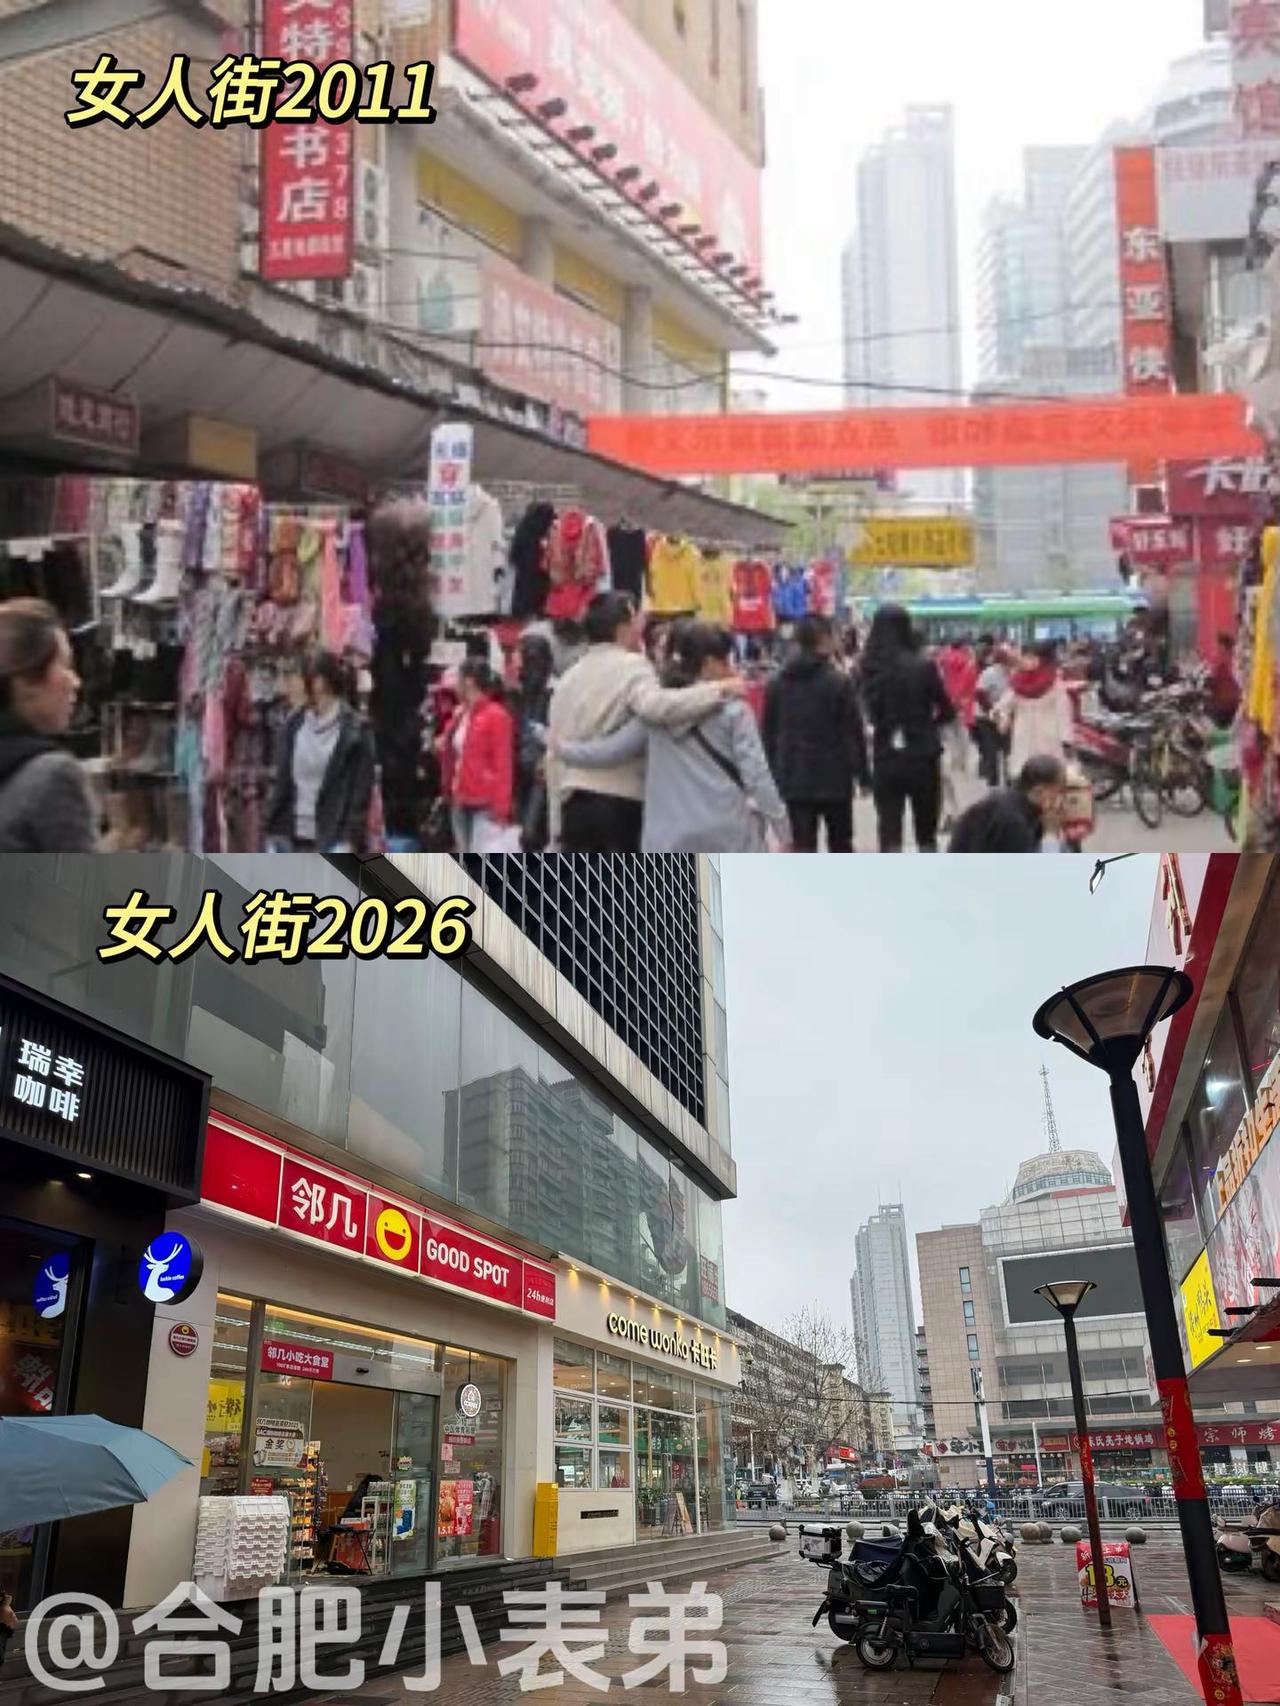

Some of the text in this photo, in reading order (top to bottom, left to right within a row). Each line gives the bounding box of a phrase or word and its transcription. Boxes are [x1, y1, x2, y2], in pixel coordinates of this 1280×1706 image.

[276, 0, 334, 222] 特书店
[17, 1038, 85, 1087] 瑞幸
[13, 1073, 81, 1122] 咖啡
[290, 1177, 358, 1240] 邻几
[425, 1238, 510, 1288] GOOD SPOT
[267, 1345, 329, 1368] 邻几小吃大食堂
[608, 1311, 648, 1344] come
[690, 1339, 718, 1370] 卡旺卡
[264, 1438, 285, 1450] 金奖
[1080, 1545, 1122, 1561] 新上市
